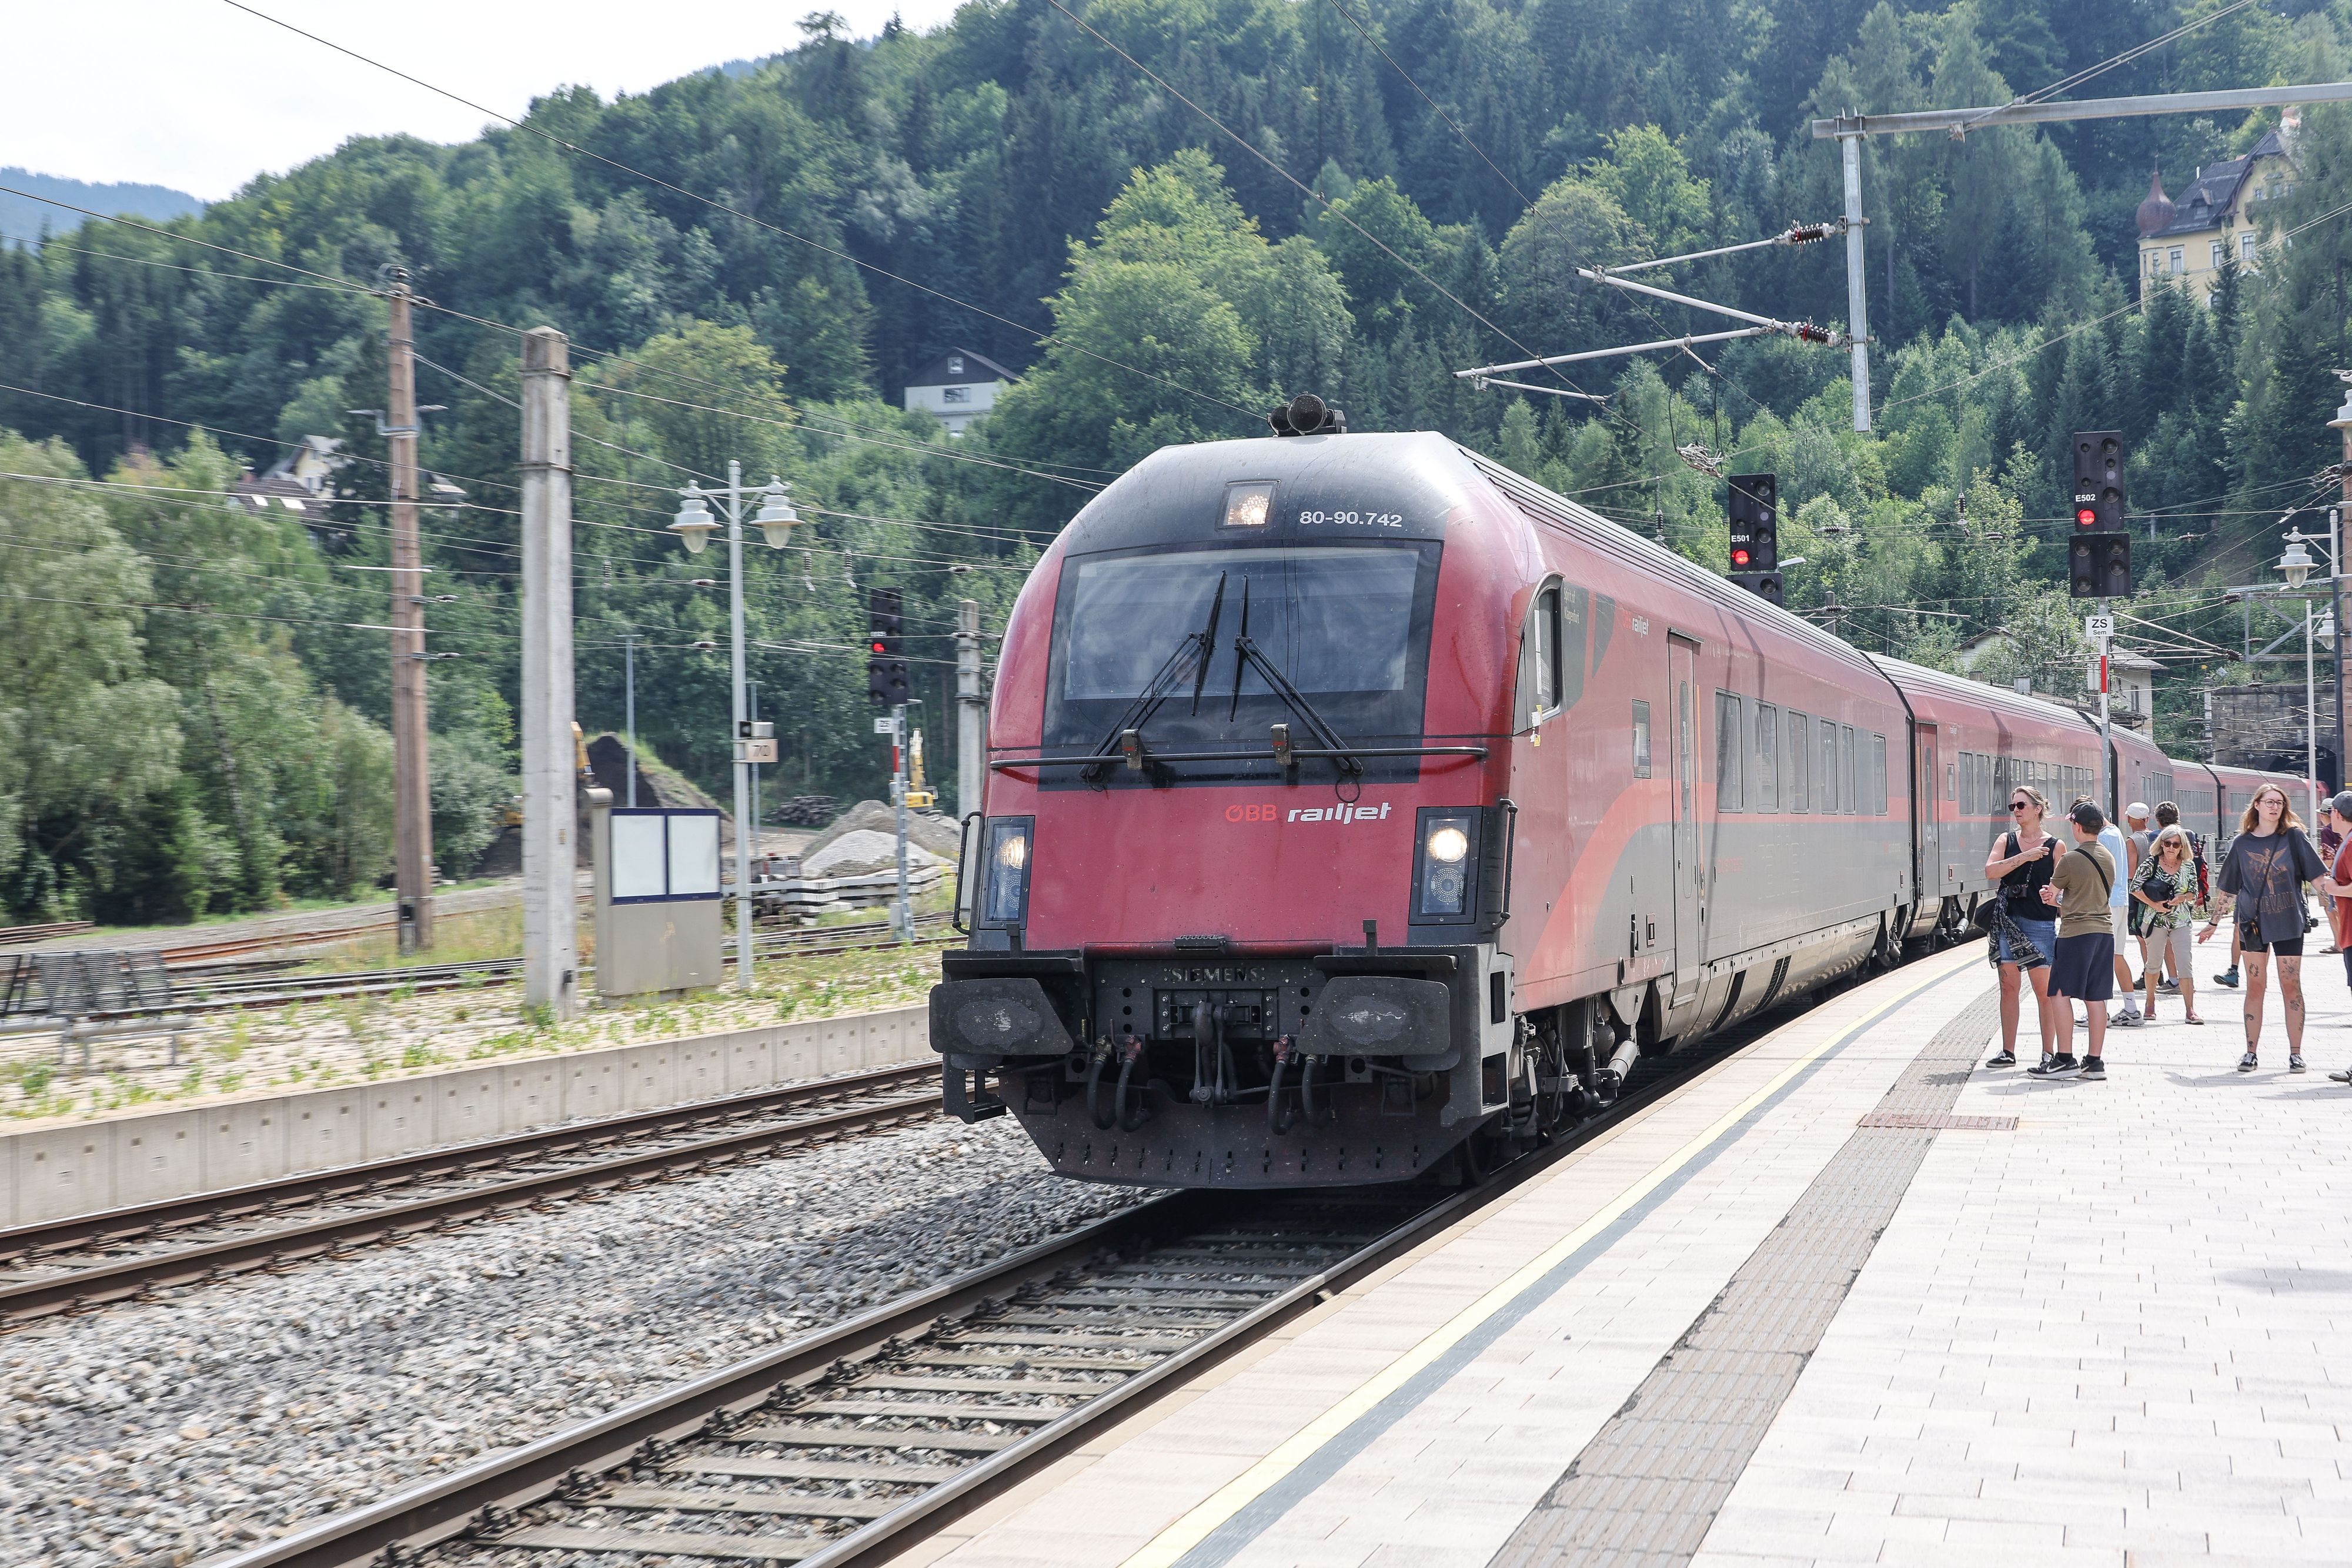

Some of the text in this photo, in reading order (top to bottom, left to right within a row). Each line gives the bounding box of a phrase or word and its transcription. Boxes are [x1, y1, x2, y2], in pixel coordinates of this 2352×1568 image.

[2075, 493, 2096, 502] E502
[1299, 510, 1403, 528] 80-90.742
[1731, 534, 1750, 543] E501
[1632, 614, 1649, 638] railjet
[2092, 618, 2108, 628] ZS
[1287, 802, 1392, 824] railjet
[1171, 968, 1258, 982] SIEMENS
